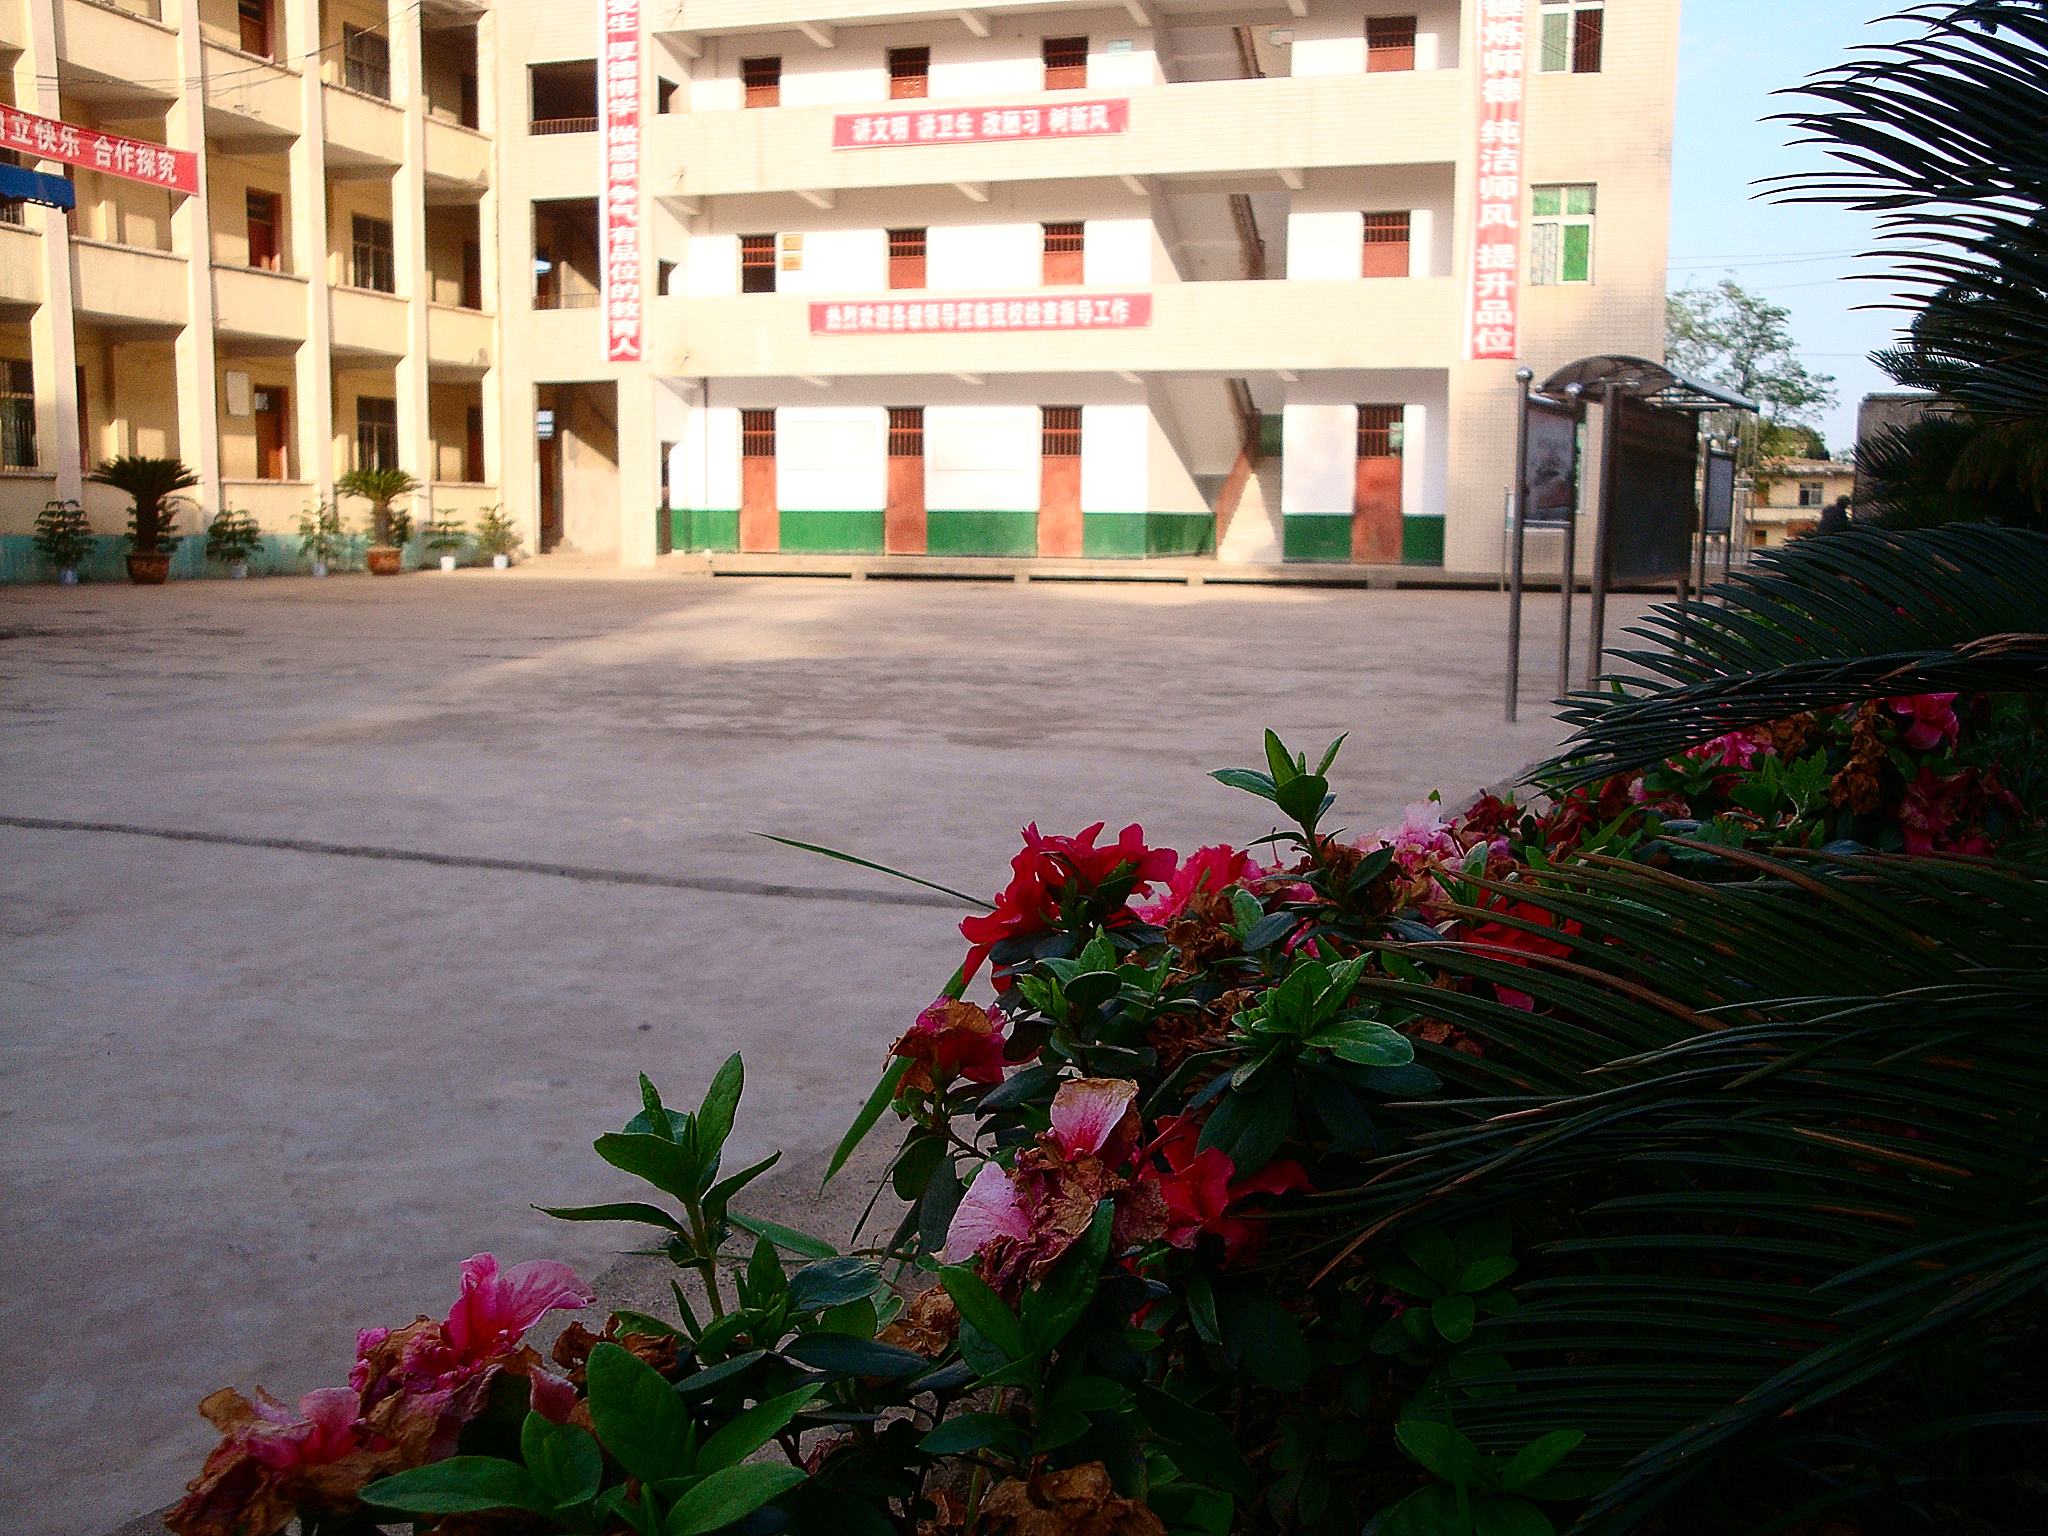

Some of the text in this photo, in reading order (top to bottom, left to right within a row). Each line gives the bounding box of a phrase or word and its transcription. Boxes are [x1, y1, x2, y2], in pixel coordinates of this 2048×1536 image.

[0, 110, 177, 183] 立快乐 合作探究
[852, 115, 910, 142] 讲文明
[917, 112, 974, 139] 讲卫生
[1049, 104, 1110, 133] 树新风
[1478, 118, 1521, 228] 纯洁师风
[1474, 243, 1516, 352] 提升品位
